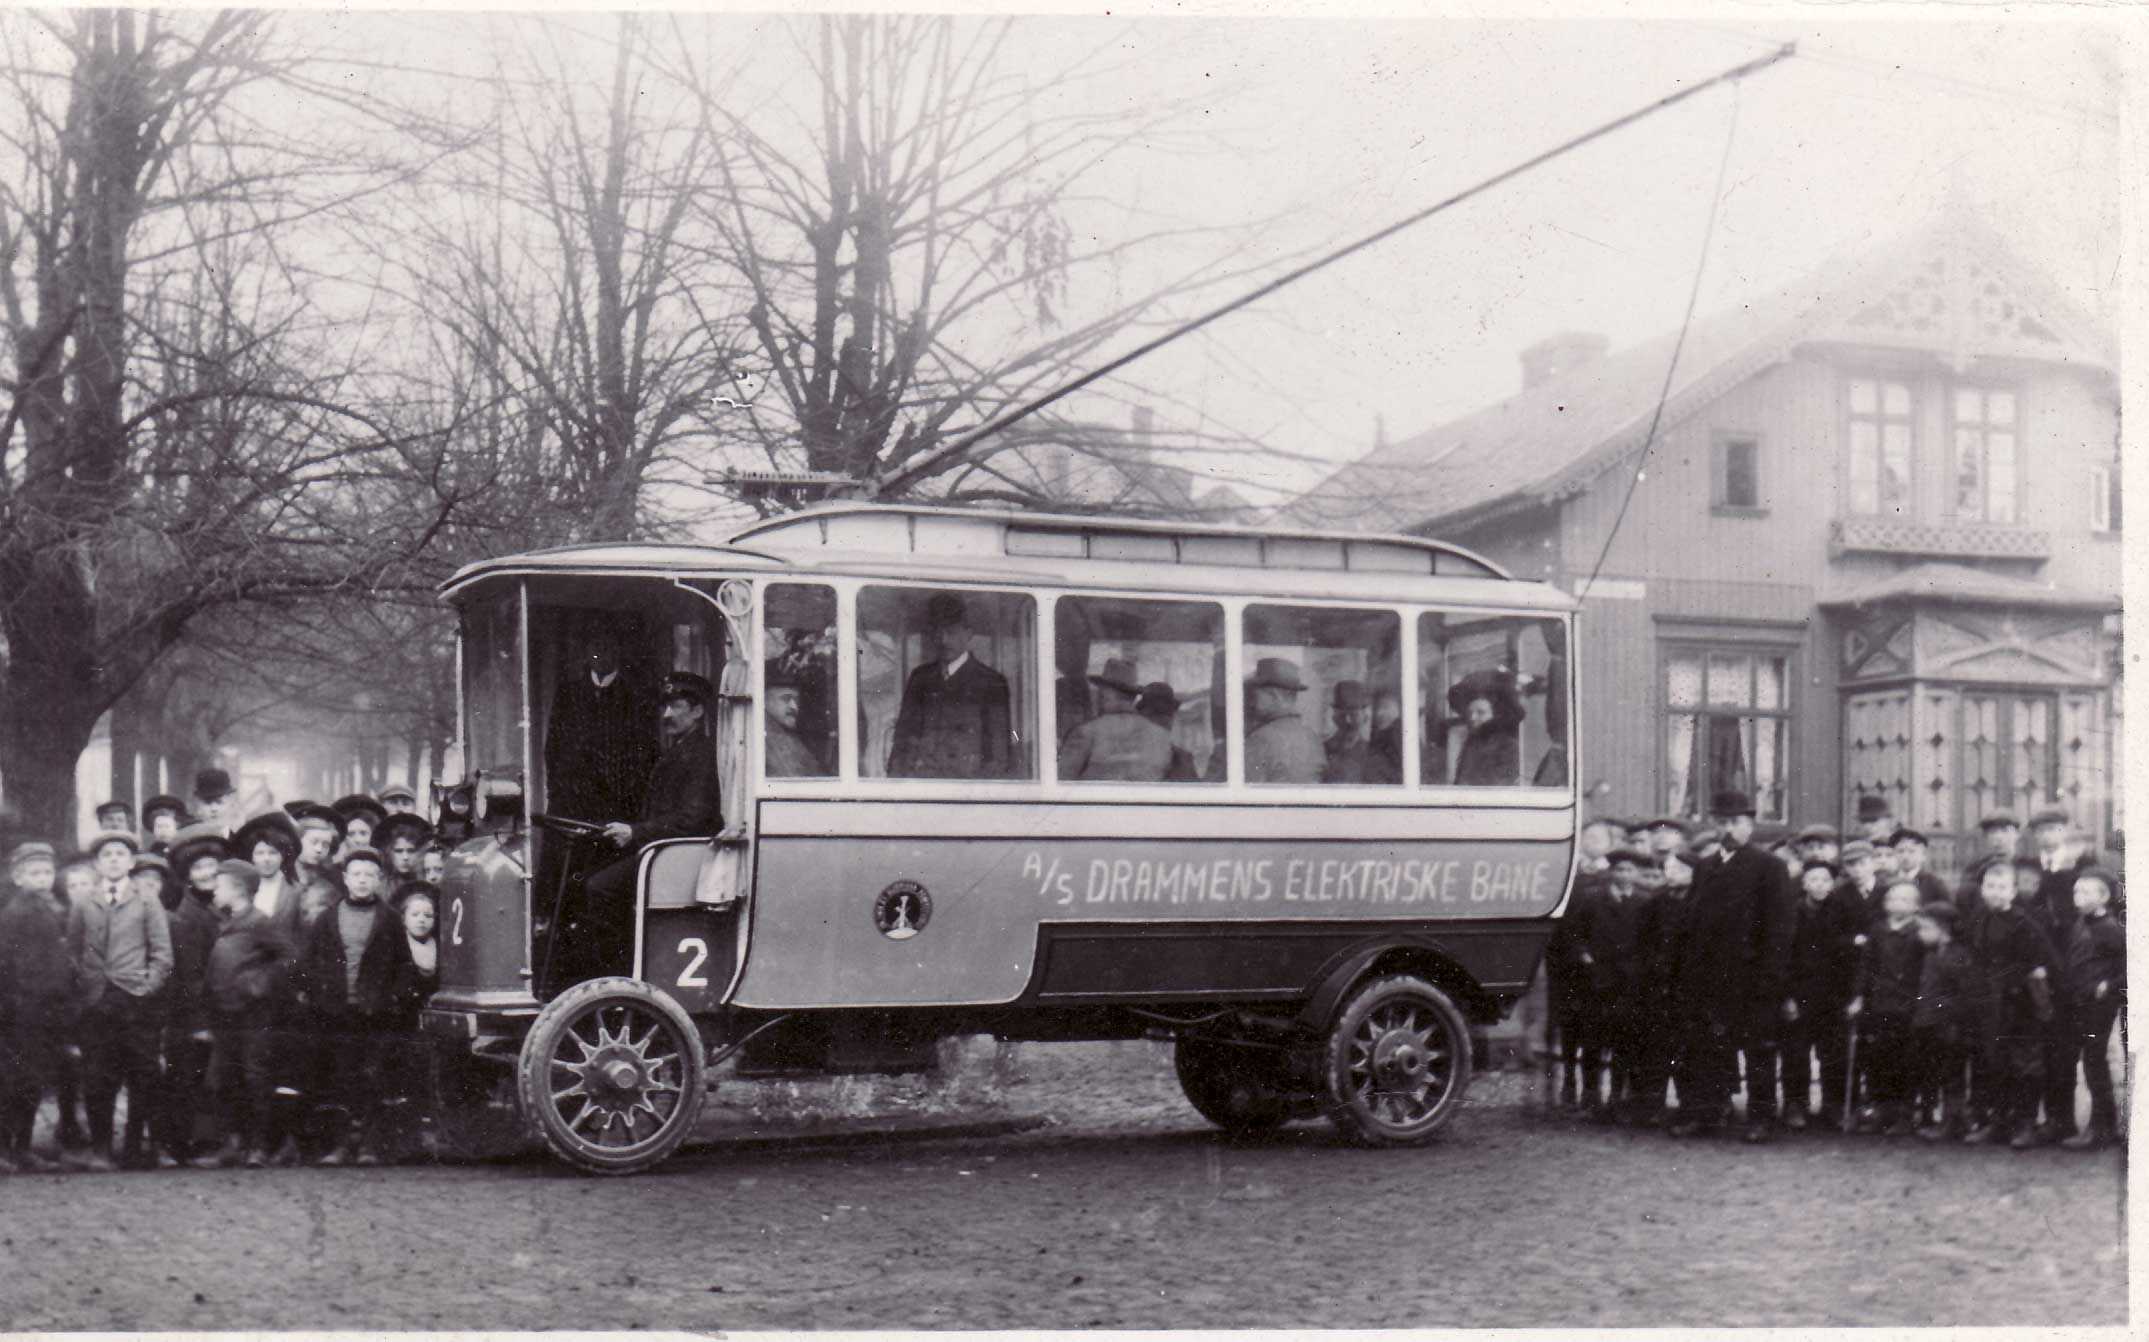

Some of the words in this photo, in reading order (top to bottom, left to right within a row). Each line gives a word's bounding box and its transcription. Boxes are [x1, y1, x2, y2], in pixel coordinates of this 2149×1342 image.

[1022, 851, 1075, 905] A/S
[1086, 859, 1274, 903] DRAMMENS
[1284, 858, 1460, 902] ELEKTRISKE
[1470, 859, 1550, 902] BANE
[452, 897, 464, 945] 2
[676, 937, 708, 987] 2
